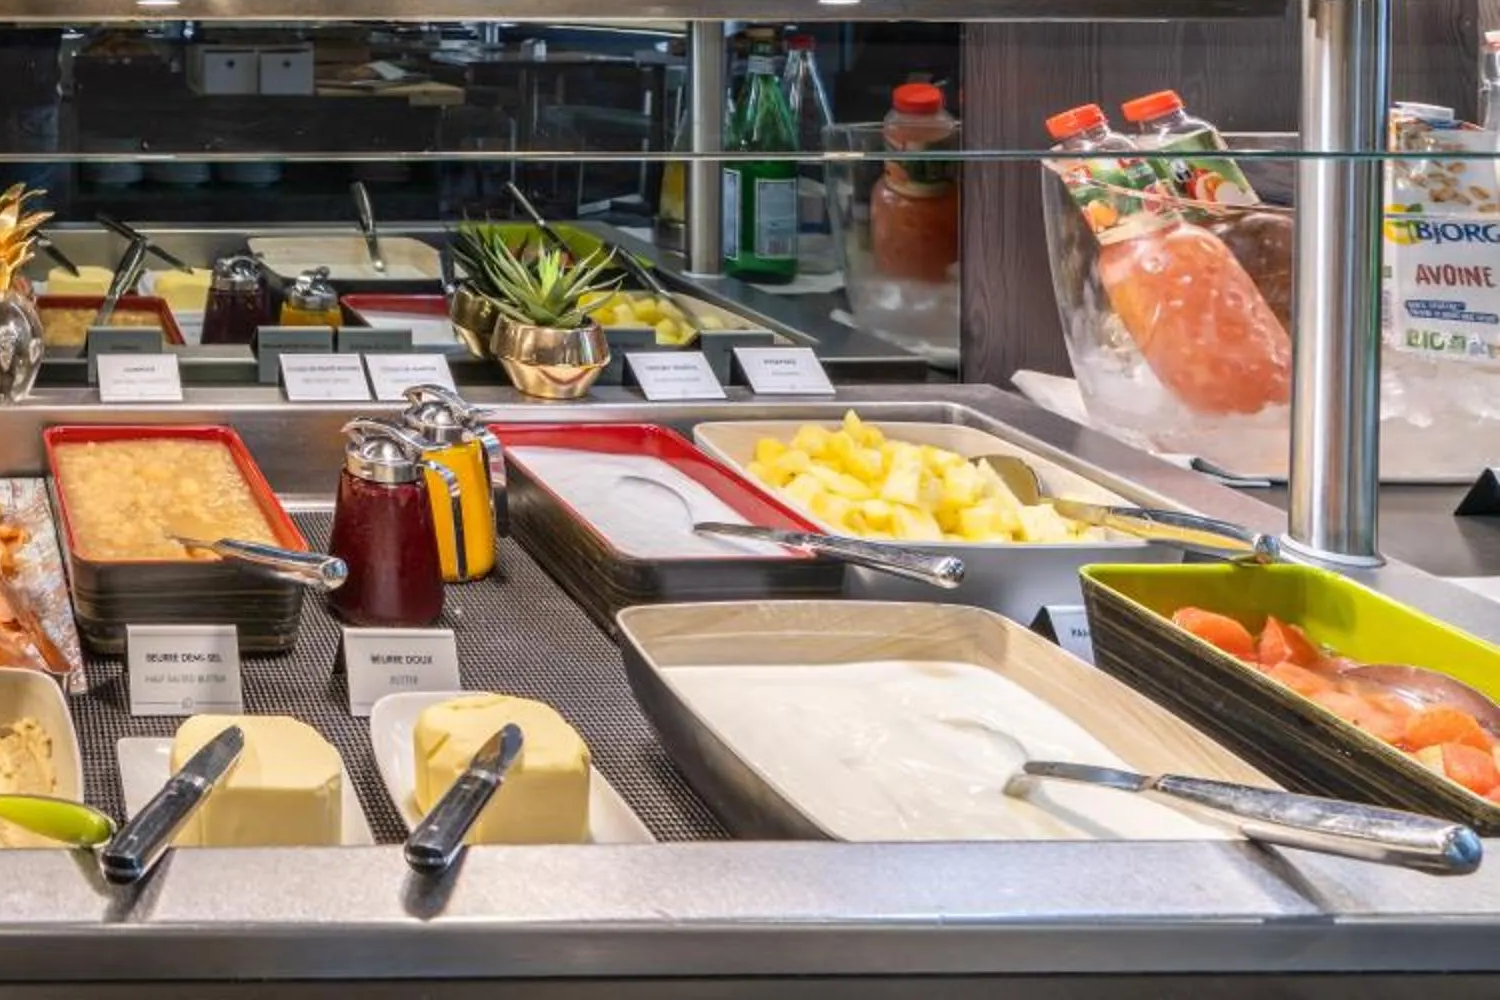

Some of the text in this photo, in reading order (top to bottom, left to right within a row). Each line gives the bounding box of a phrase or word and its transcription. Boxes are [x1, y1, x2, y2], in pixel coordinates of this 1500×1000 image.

[1416, 263, 1498, 288] AVOINE
[1406, 329, 1446, 350] BIO
[146, 653, 178, 662] BEURRE
[370, 654, 433, 664] BEURRE DOUX
